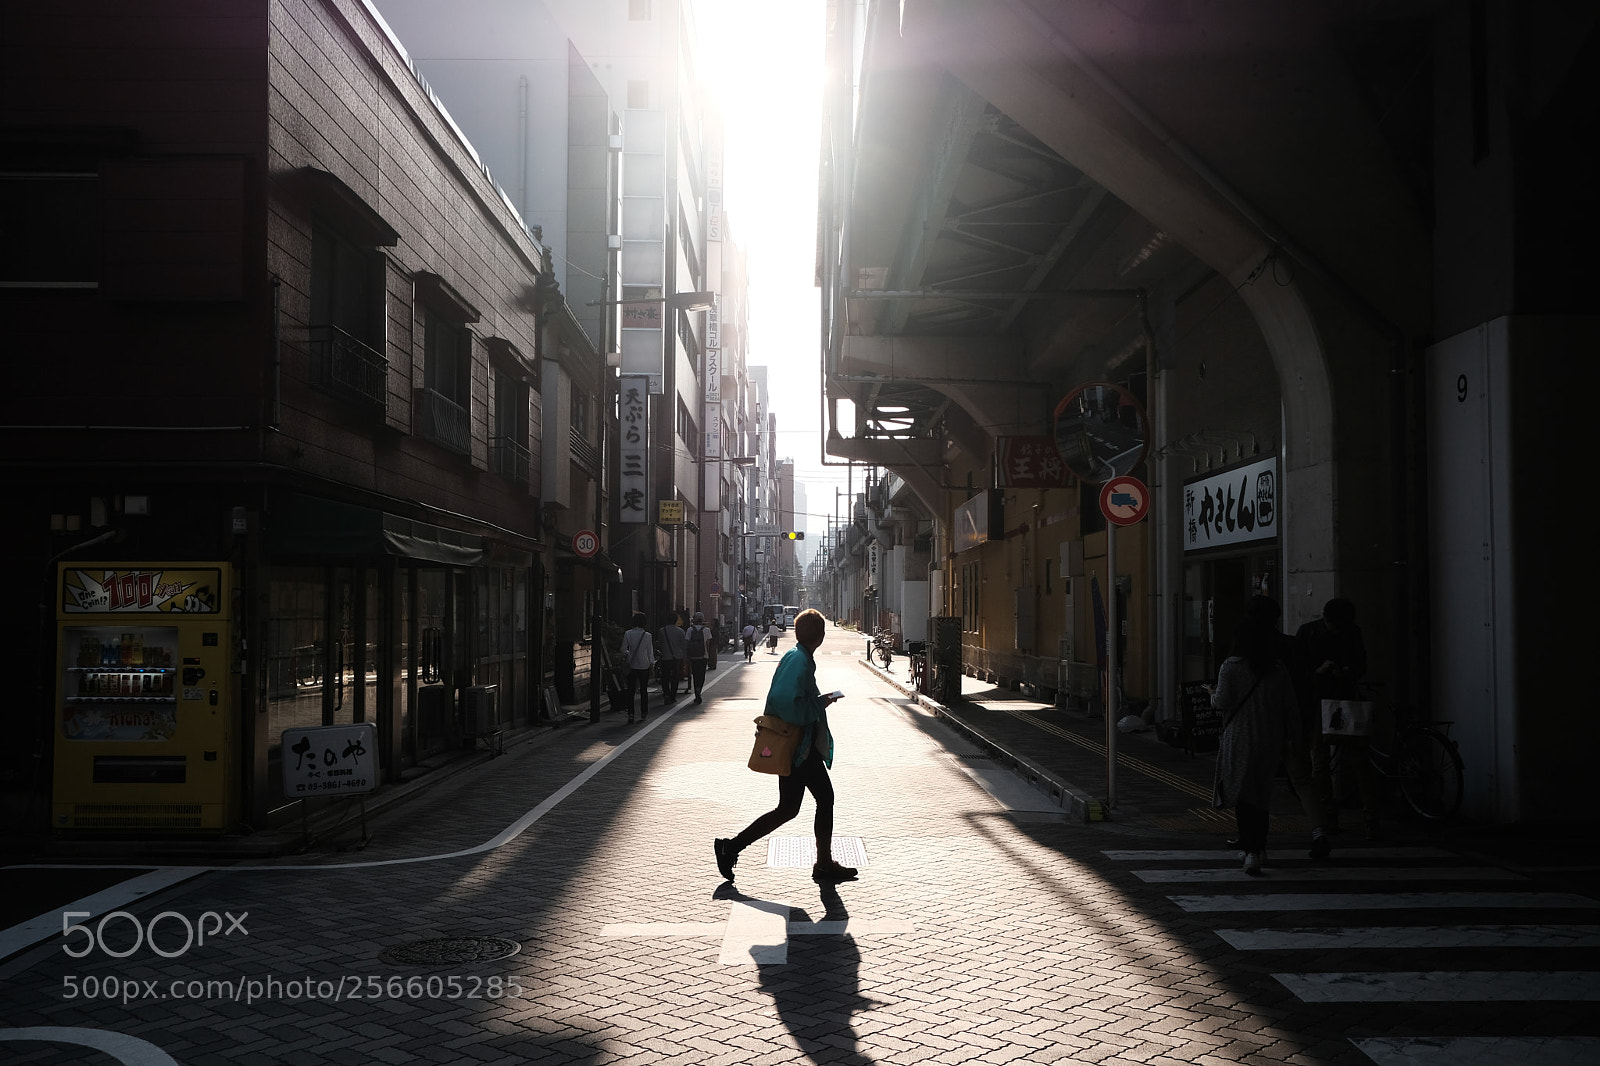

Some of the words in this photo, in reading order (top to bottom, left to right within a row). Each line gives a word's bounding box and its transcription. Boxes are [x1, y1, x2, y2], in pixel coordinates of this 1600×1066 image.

[1457, 374, 1468, 402] 9
[1012, 456, 1062, 480] 王将
[1186, 490, 1197, 544] 新橋
[1199, 475, 1255, 540] やきとん
[579, 538, 593, 549] 30
[78, 590, 96, 600] One
[102, 572, 153, 610] 100
[292, 736, 366, 770] たのや
